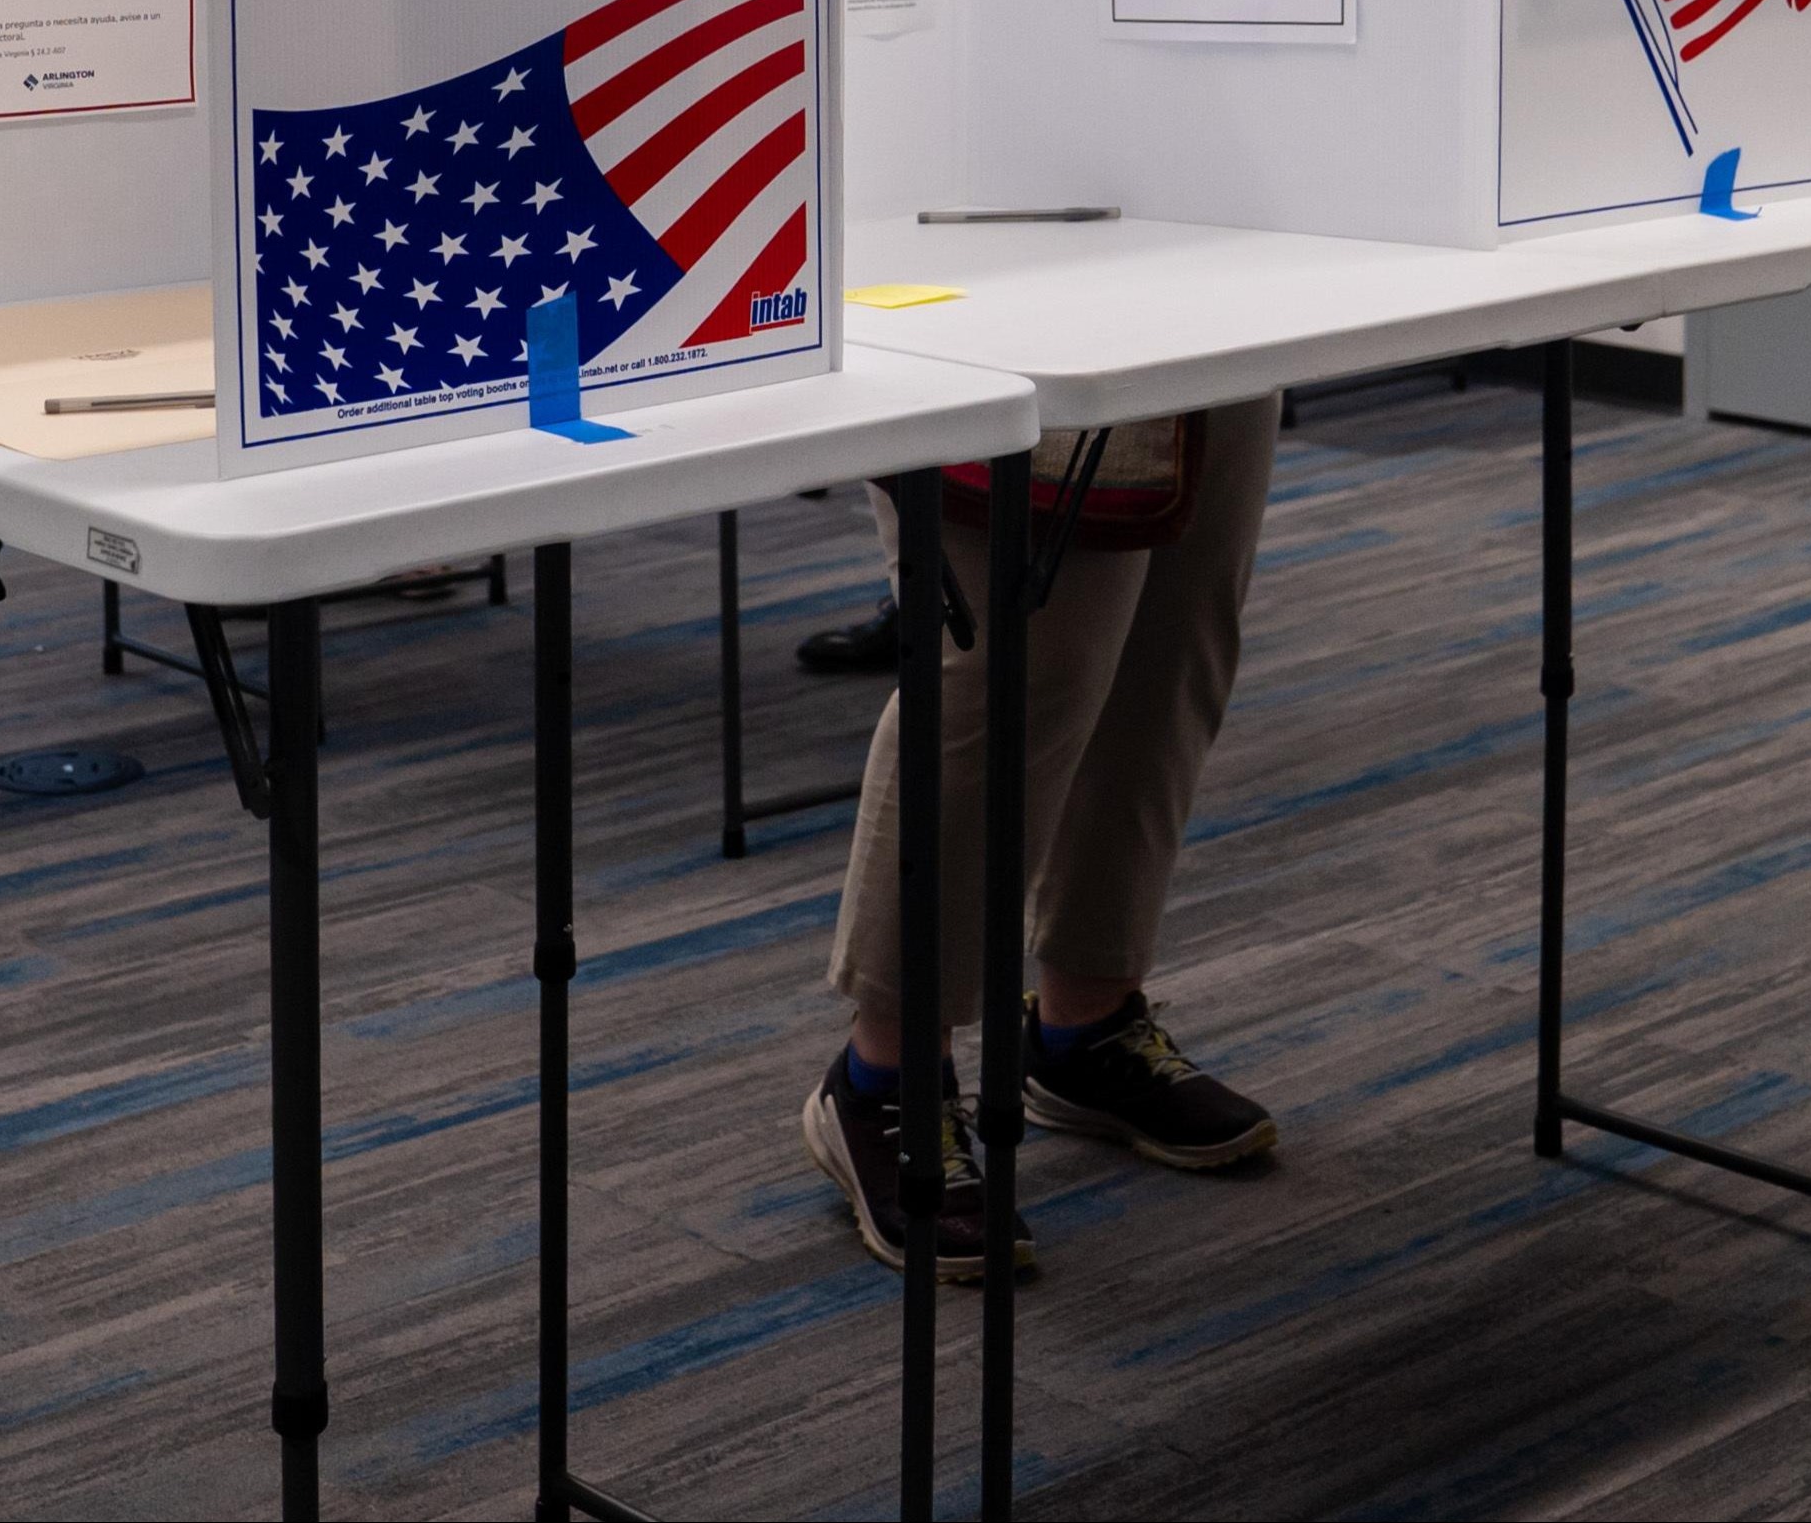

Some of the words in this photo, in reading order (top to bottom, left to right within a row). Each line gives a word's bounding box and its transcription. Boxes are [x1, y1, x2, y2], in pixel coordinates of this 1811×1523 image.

[5, 19, 44, 32] pregunta
[53, 16, 88, 26] necesita
[90, 14, 118, 27] ayuda,
[119, 13, 141, 22] avise
[143, 13, 149, 21] a
[150, 11, 161, 20] un
[42, 69, 95, 82] ARLINGTON
[751, 288, 807, 326] intab
[337, 407, 364, 419] Order
[366, 397, 412, 415] additional
[414, 395, 437, 408] table
[438, 392, 454, 404] top
[456, 386, 484, 400] voting
[486, 382, 517, 395] booths
[620, 363, 629, 372] or
[631, 359, 646, 370] call
